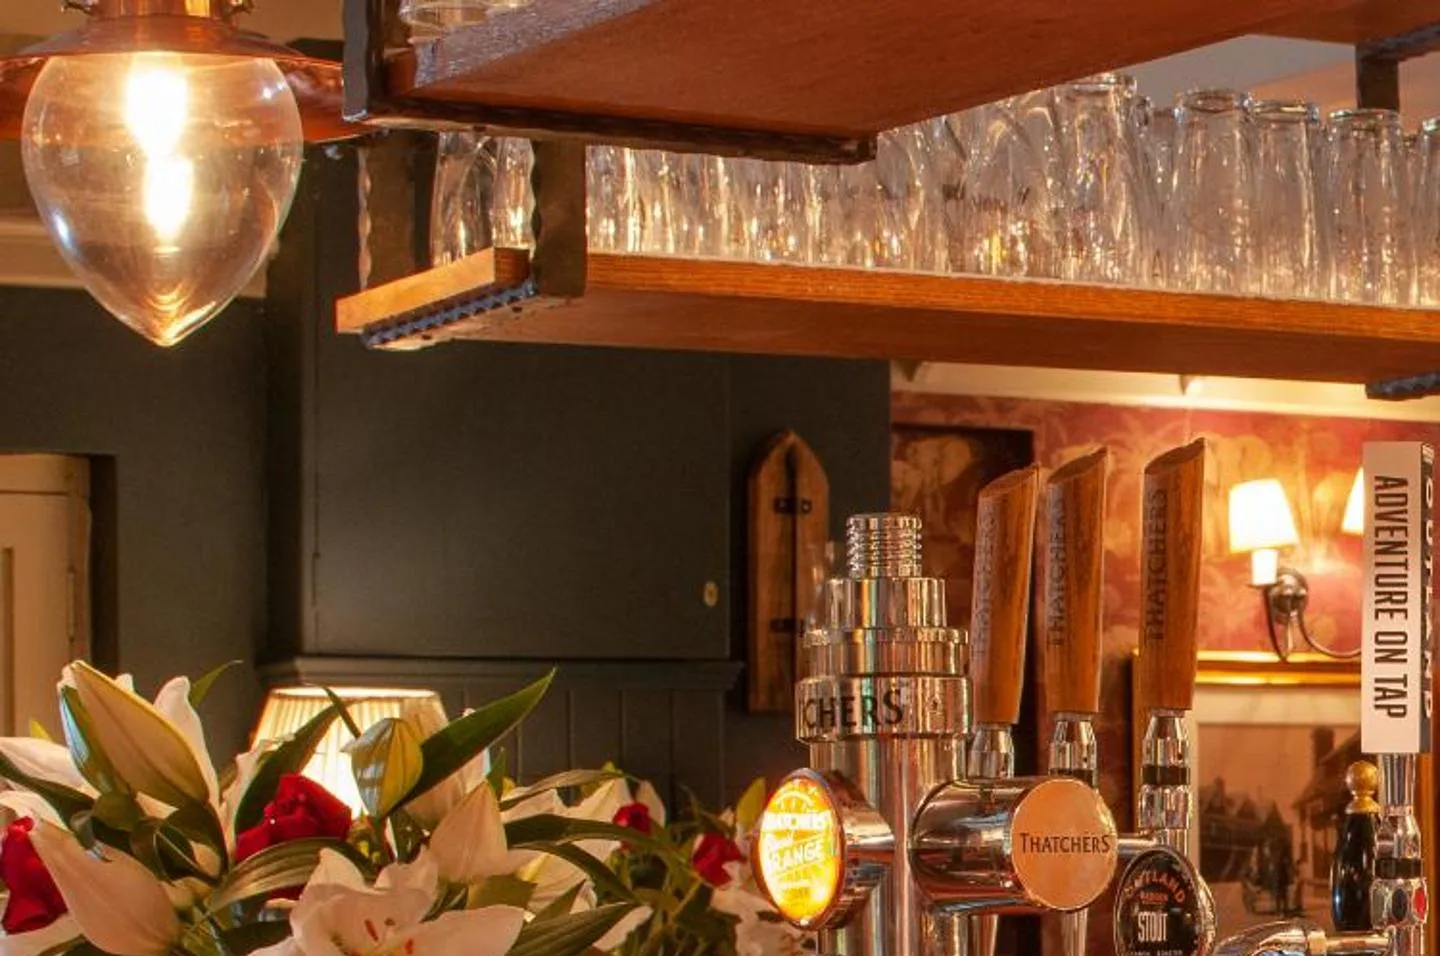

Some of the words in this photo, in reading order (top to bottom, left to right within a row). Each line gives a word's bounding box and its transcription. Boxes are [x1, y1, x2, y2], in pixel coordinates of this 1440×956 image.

[1374, 476, 1408, 621] ADVENTURE
[1374, 630, 1408, 664] ON
[1374, 673, 1408, 719] TAP
[1020, 832, 1110, 854] THATCHERS
[1137, 911, 1169, 942] STOUT
